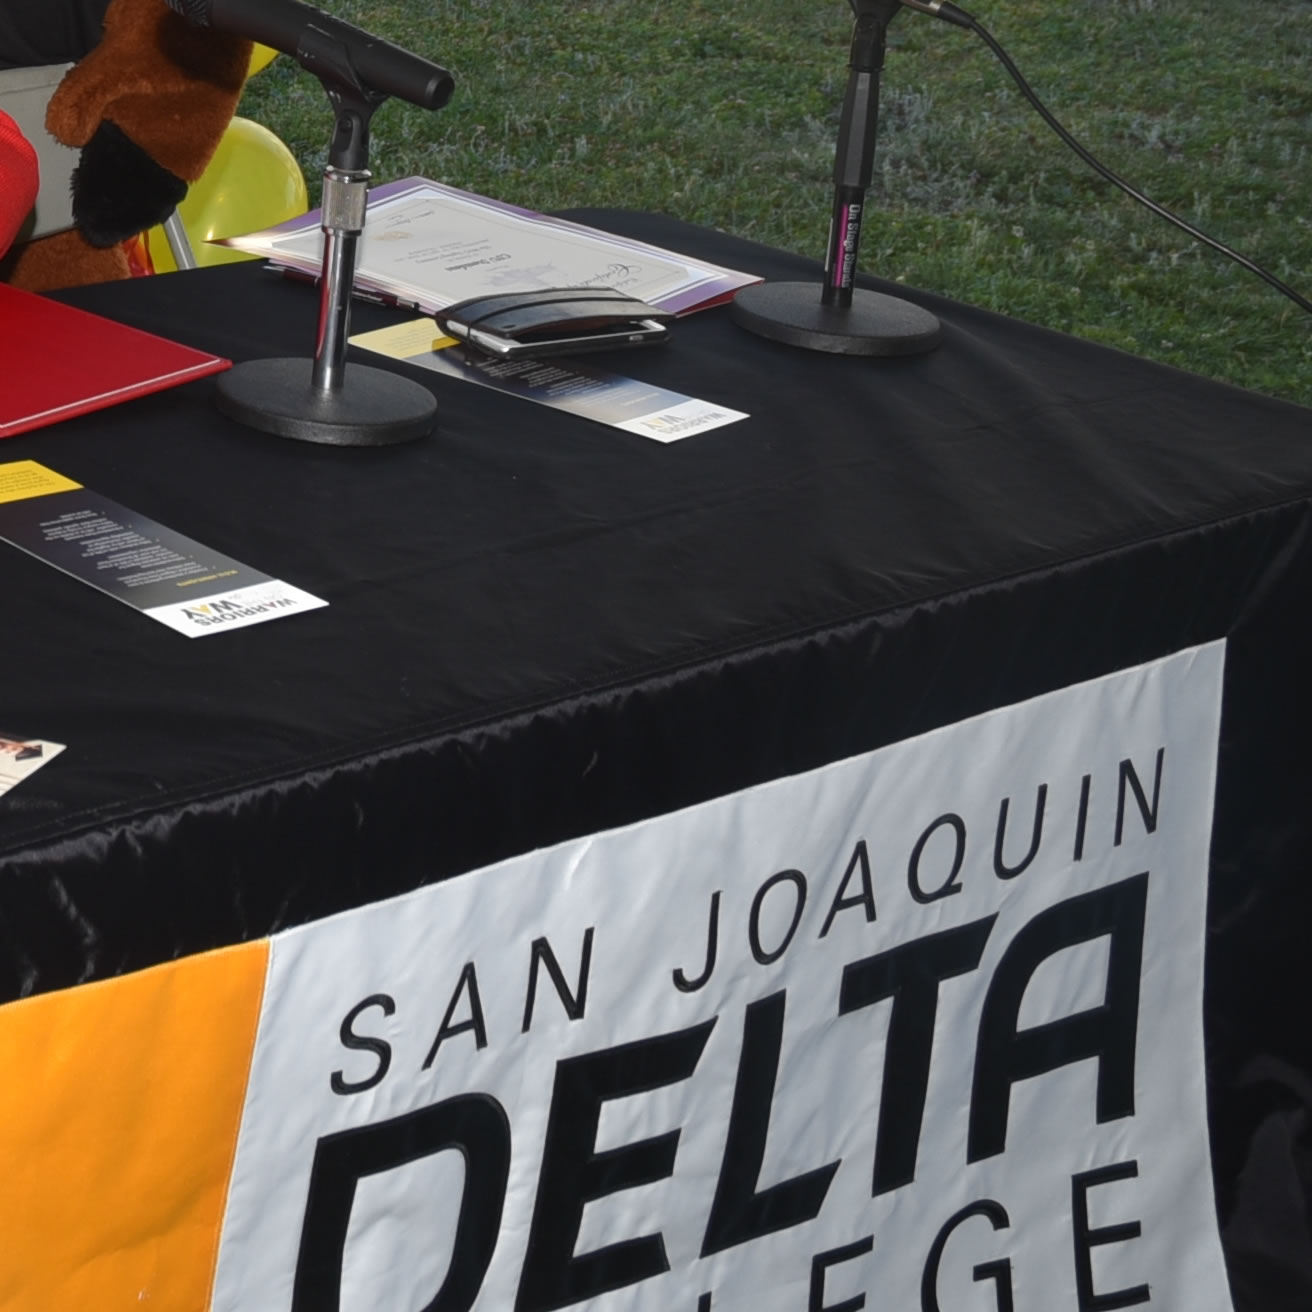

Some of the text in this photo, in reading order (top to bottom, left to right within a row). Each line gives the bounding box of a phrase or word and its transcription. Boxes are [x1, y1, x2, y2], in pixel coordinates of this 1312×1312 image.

[180, 599, 242, 621] WAY
[193, 597, 299, 627] WARRIORS
[329, 746, 1166, 1096] SAN JOAQUIN
[290, 872, 1151, 1312] DELTA
